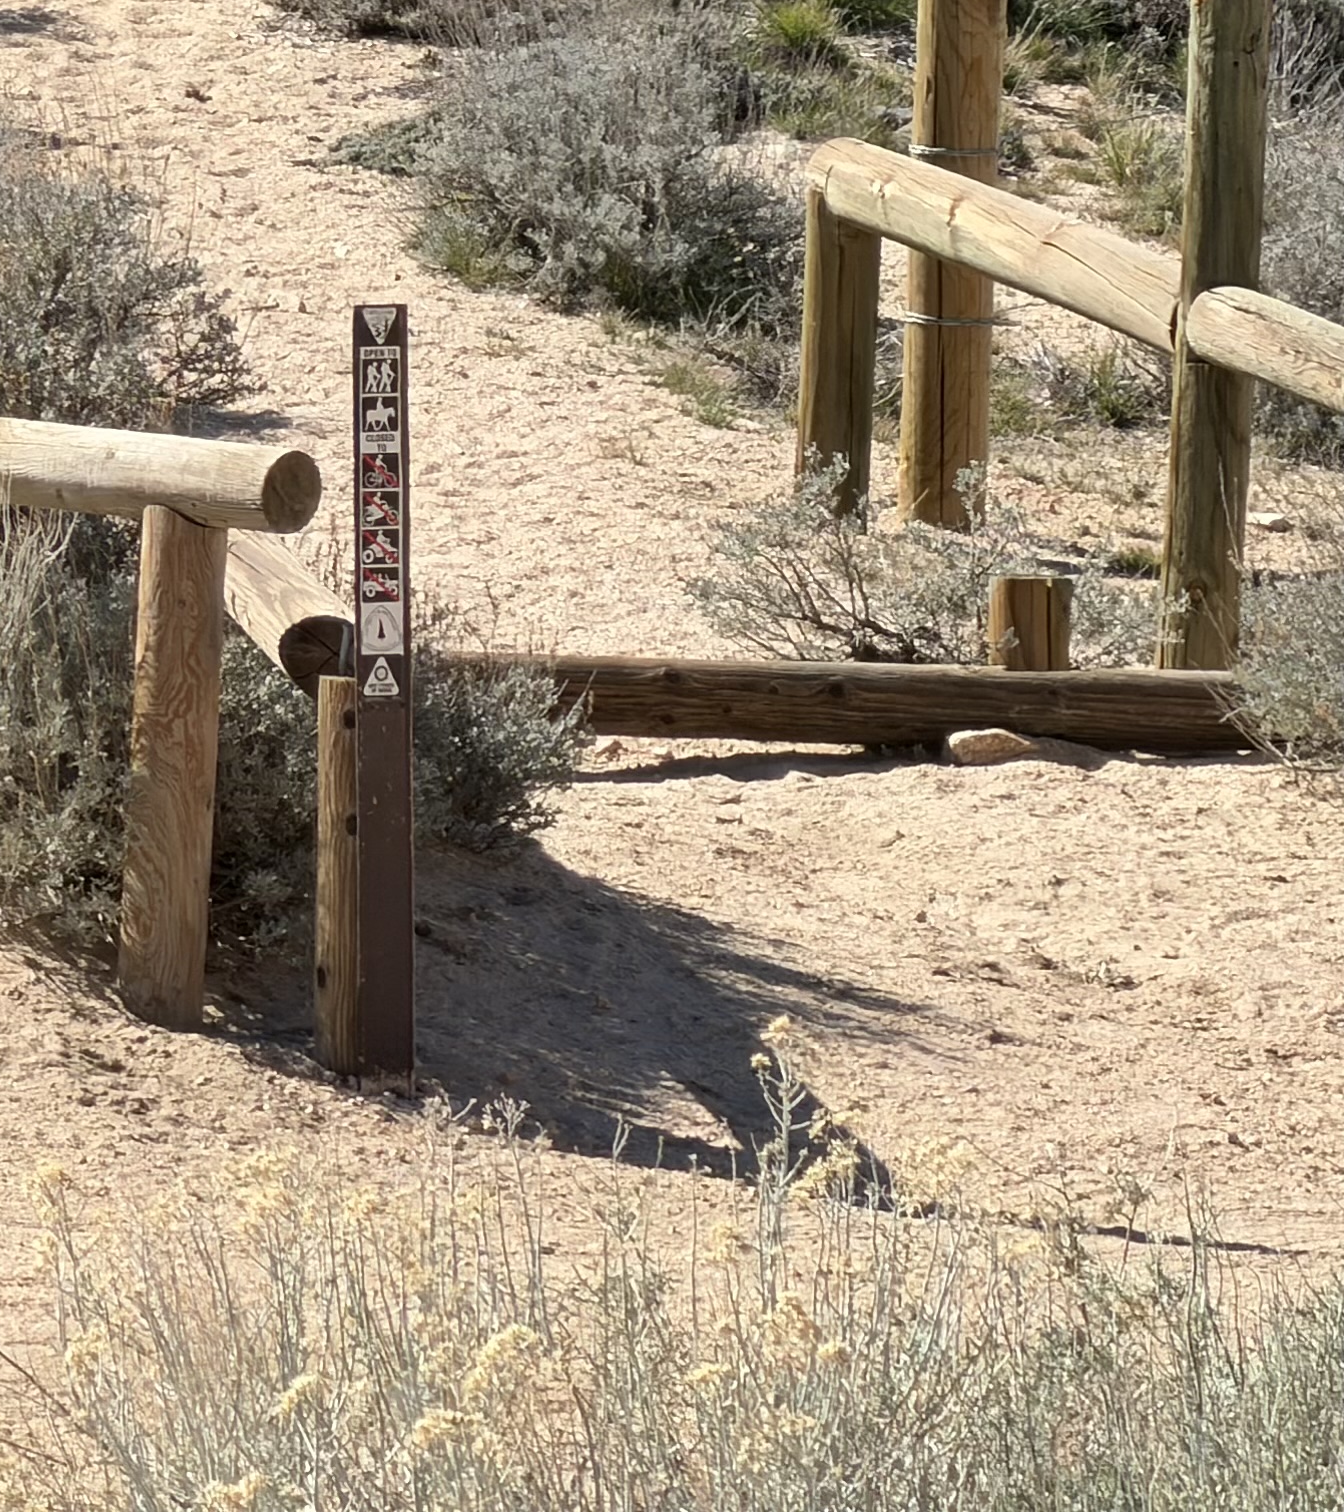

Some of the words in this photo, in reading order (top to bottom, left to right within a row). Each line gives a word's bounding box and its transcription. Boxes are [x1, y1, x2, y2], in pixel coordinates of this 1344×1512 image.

[363, 348, 385, 358] OPEN
[387, 348, 397, 358] TO
[365, 433, 395, 442] CLOSED
[376, 443, 387, 452] TO
